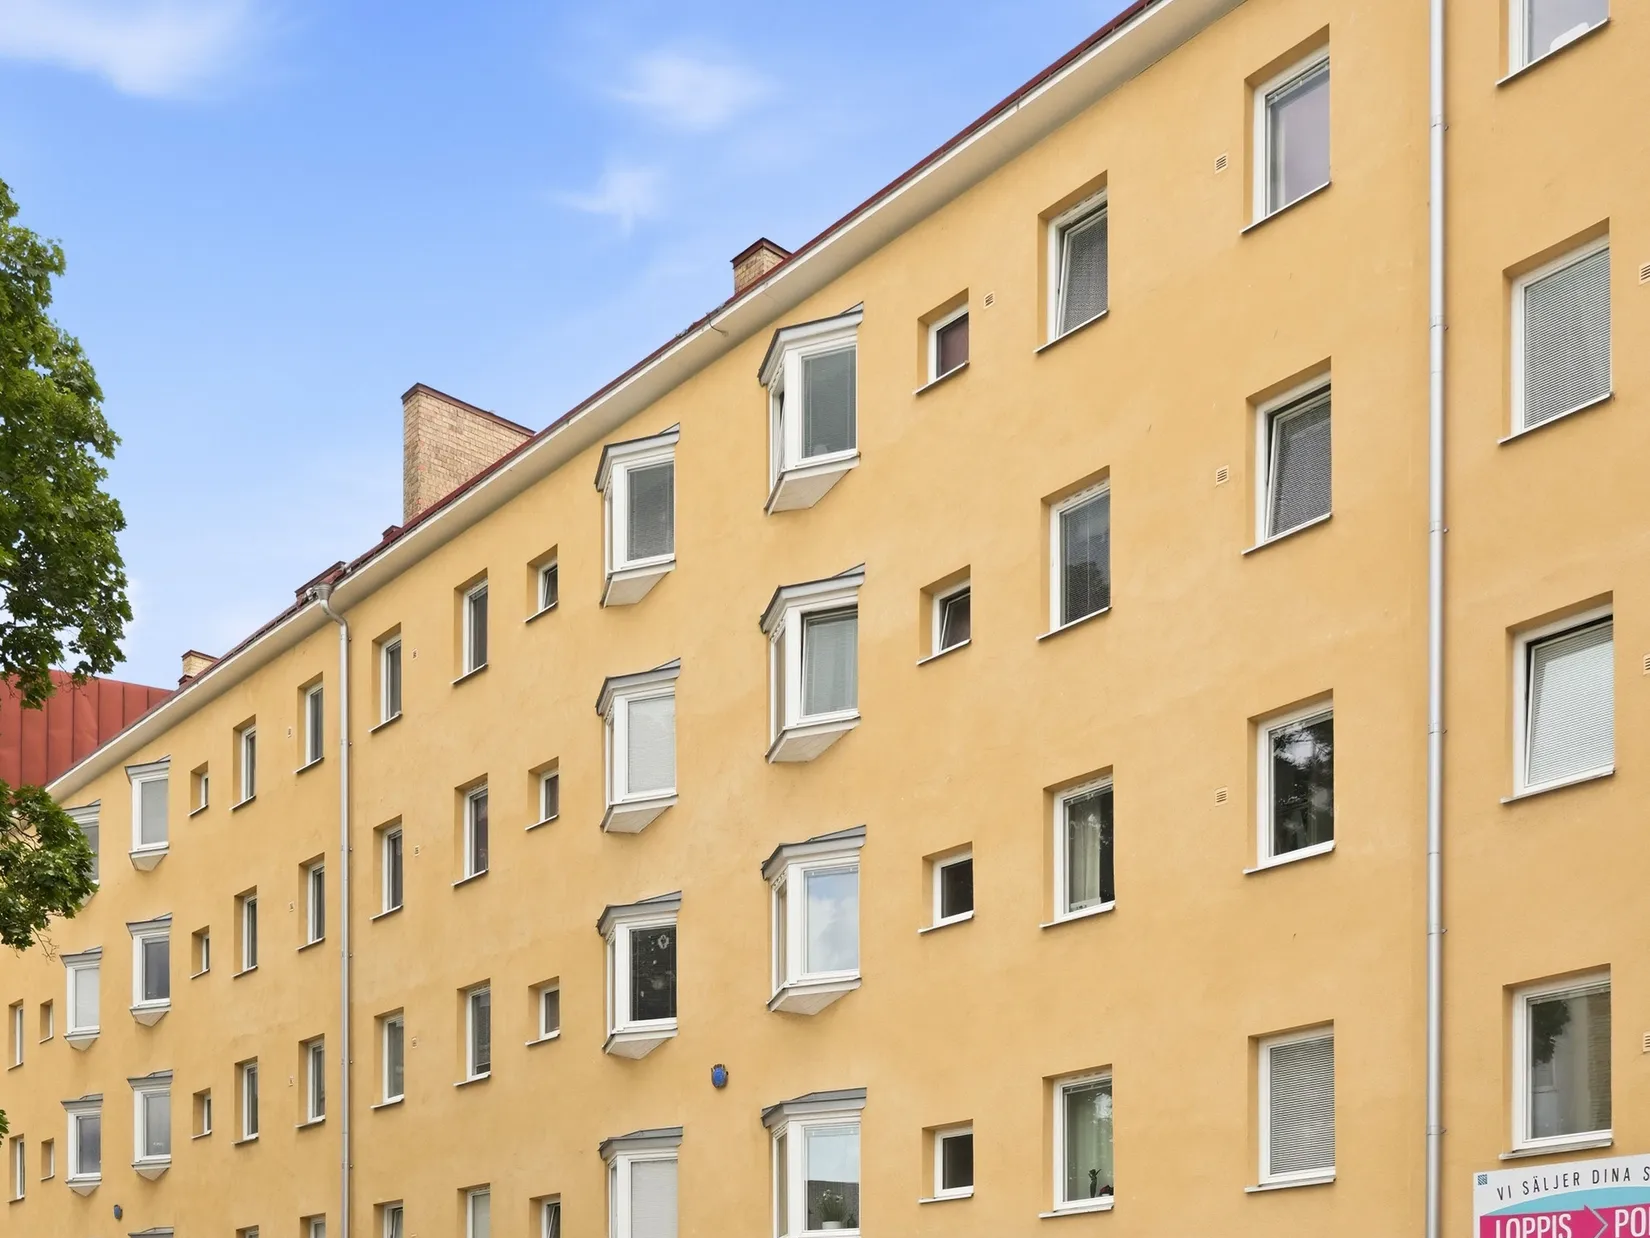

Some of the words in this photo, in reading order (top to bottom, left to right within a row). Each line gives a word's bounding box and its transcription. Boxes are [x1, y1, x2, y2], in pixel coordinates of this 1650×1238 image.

[1497, 1185, 1512, 1200] VI
[1522, 1171, 1580, 1196] SÄLJER
[1592, 1167, 1631, 1184] DINA
[1614, 1206, 1650, 1238] PO
